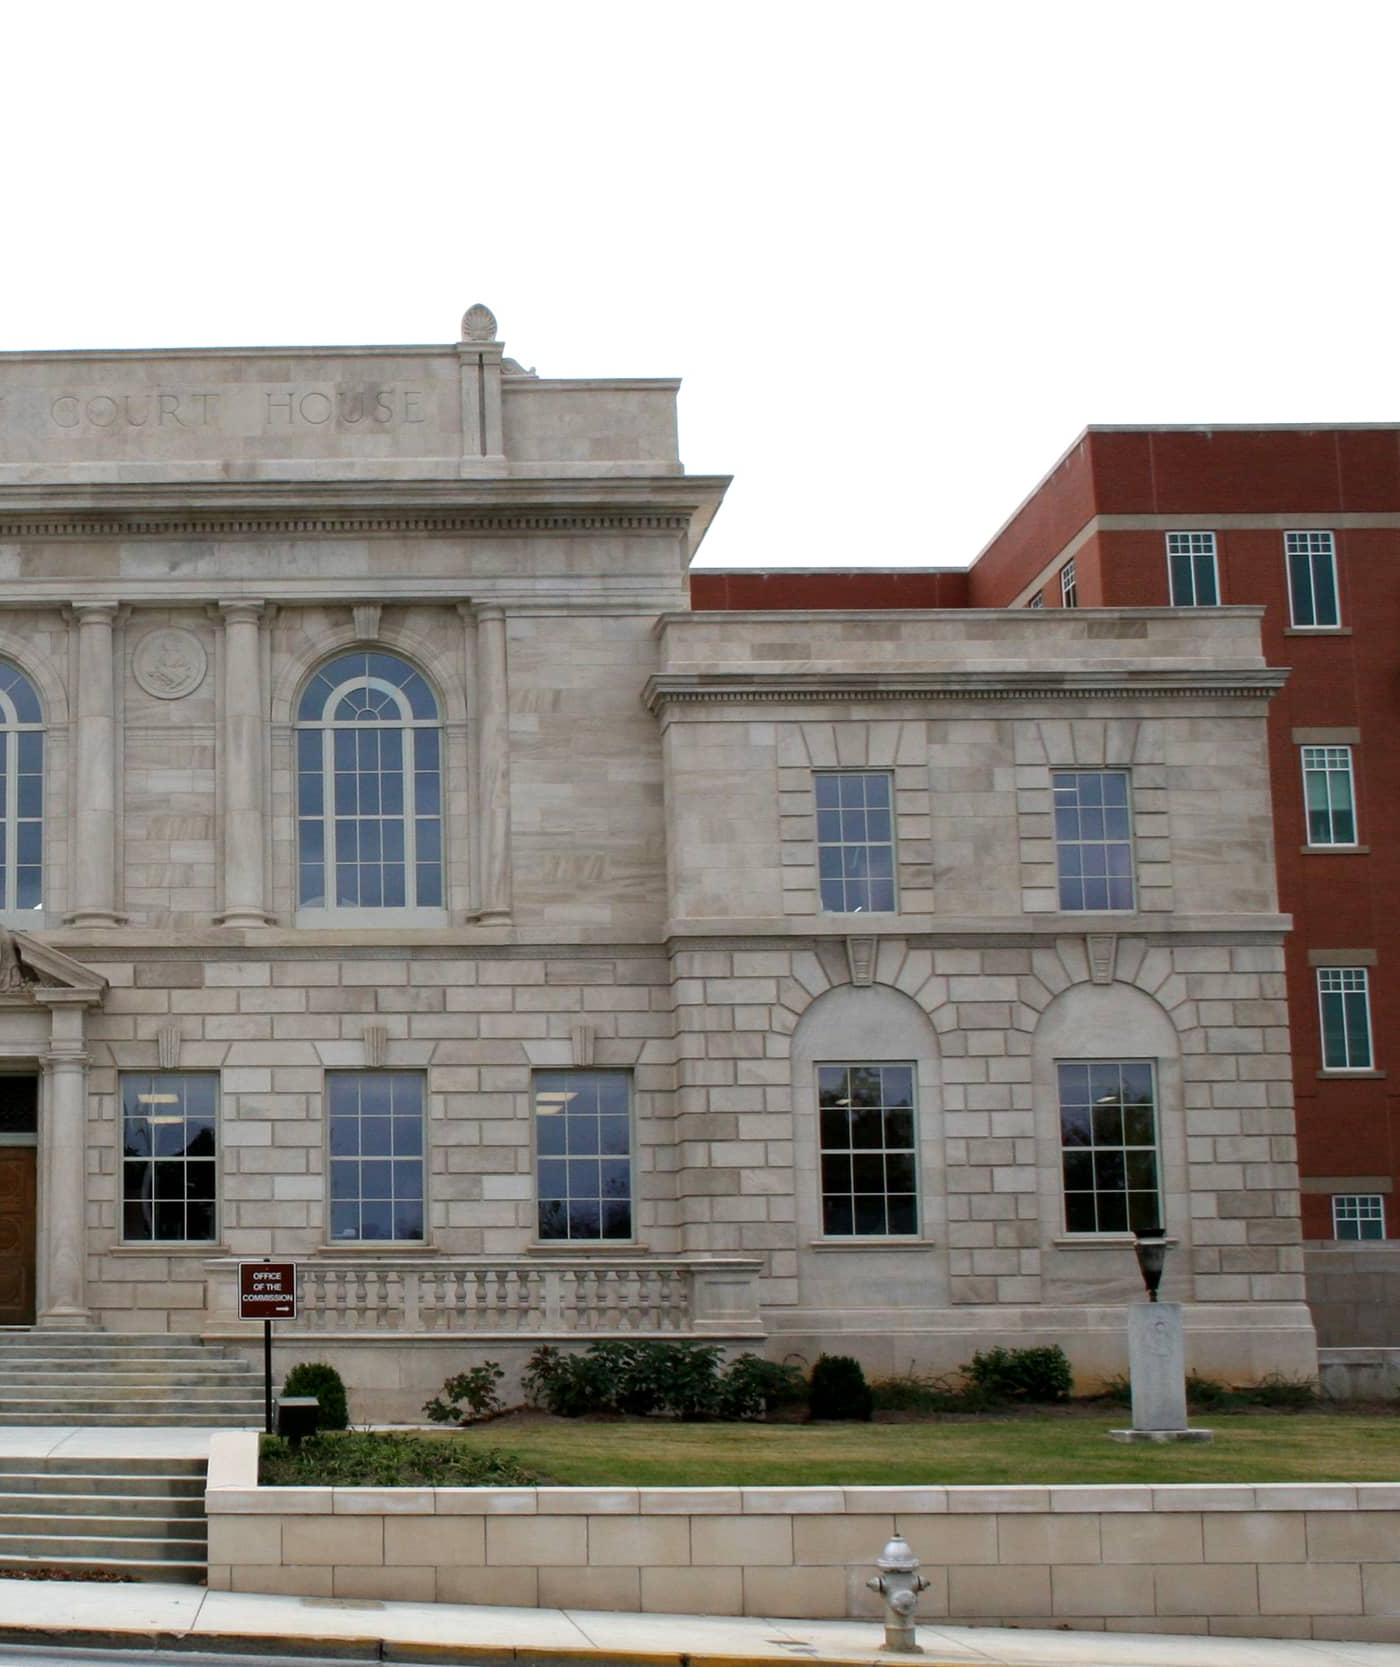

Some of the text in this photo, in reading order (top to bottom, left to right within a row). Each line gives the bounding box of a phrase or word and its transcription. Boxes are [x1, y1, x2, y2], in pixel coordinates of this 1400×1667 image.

[51, 393, 221, 428] COURT
[265, 391, 426, 425] HOUSE
[253, 1272, 282, 1280] OFFICE
[253, 1283, 282, 1291] OF THE
[242, 1294, 293, 1302] COMMISSION
